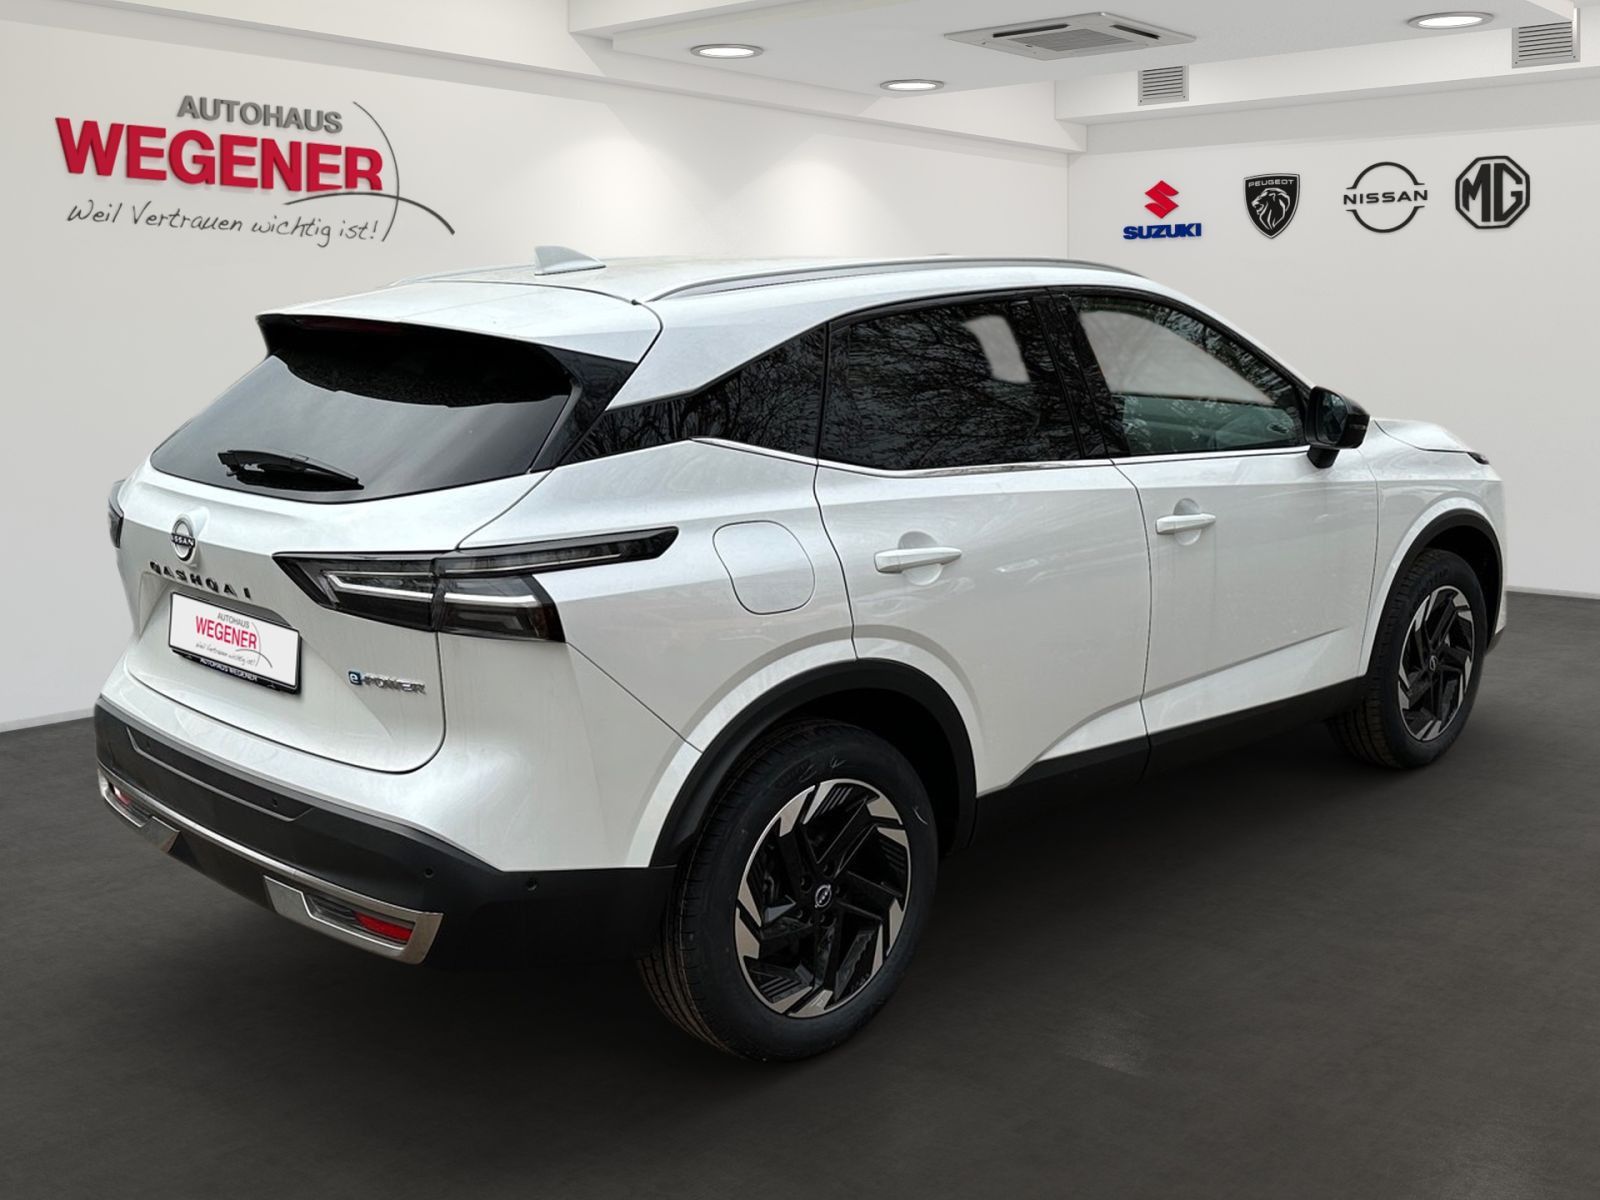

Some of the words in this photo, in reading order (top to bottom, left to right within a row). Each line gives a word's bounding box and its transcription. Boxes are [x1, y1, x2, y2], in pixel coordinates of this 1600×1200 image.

[177, 95, 343, 134] AUTOHAUS
[55, 117, 383, 193] WEGENER
[1248, 178, 1295, 188] PEUGEOT
[1343, 188, 1428, 206] NISSAN
[1461, 161, 1524, 224] MG
[66, 199, 123, 224] Weil
[132, 200, 243, 232] Vertrauen
[251, 215, 332, 248] wichtig
[339, 219, 379, 240] ist!
[1123, 222, 1202, 240] SUZUKI
[170, 533, 196, 548] SSAN
[149, 561, 252, 600] QASHQAI
[195, 615, 258, 650] WEGENER
[217, 612, 251, 629] AUTOHAUS
